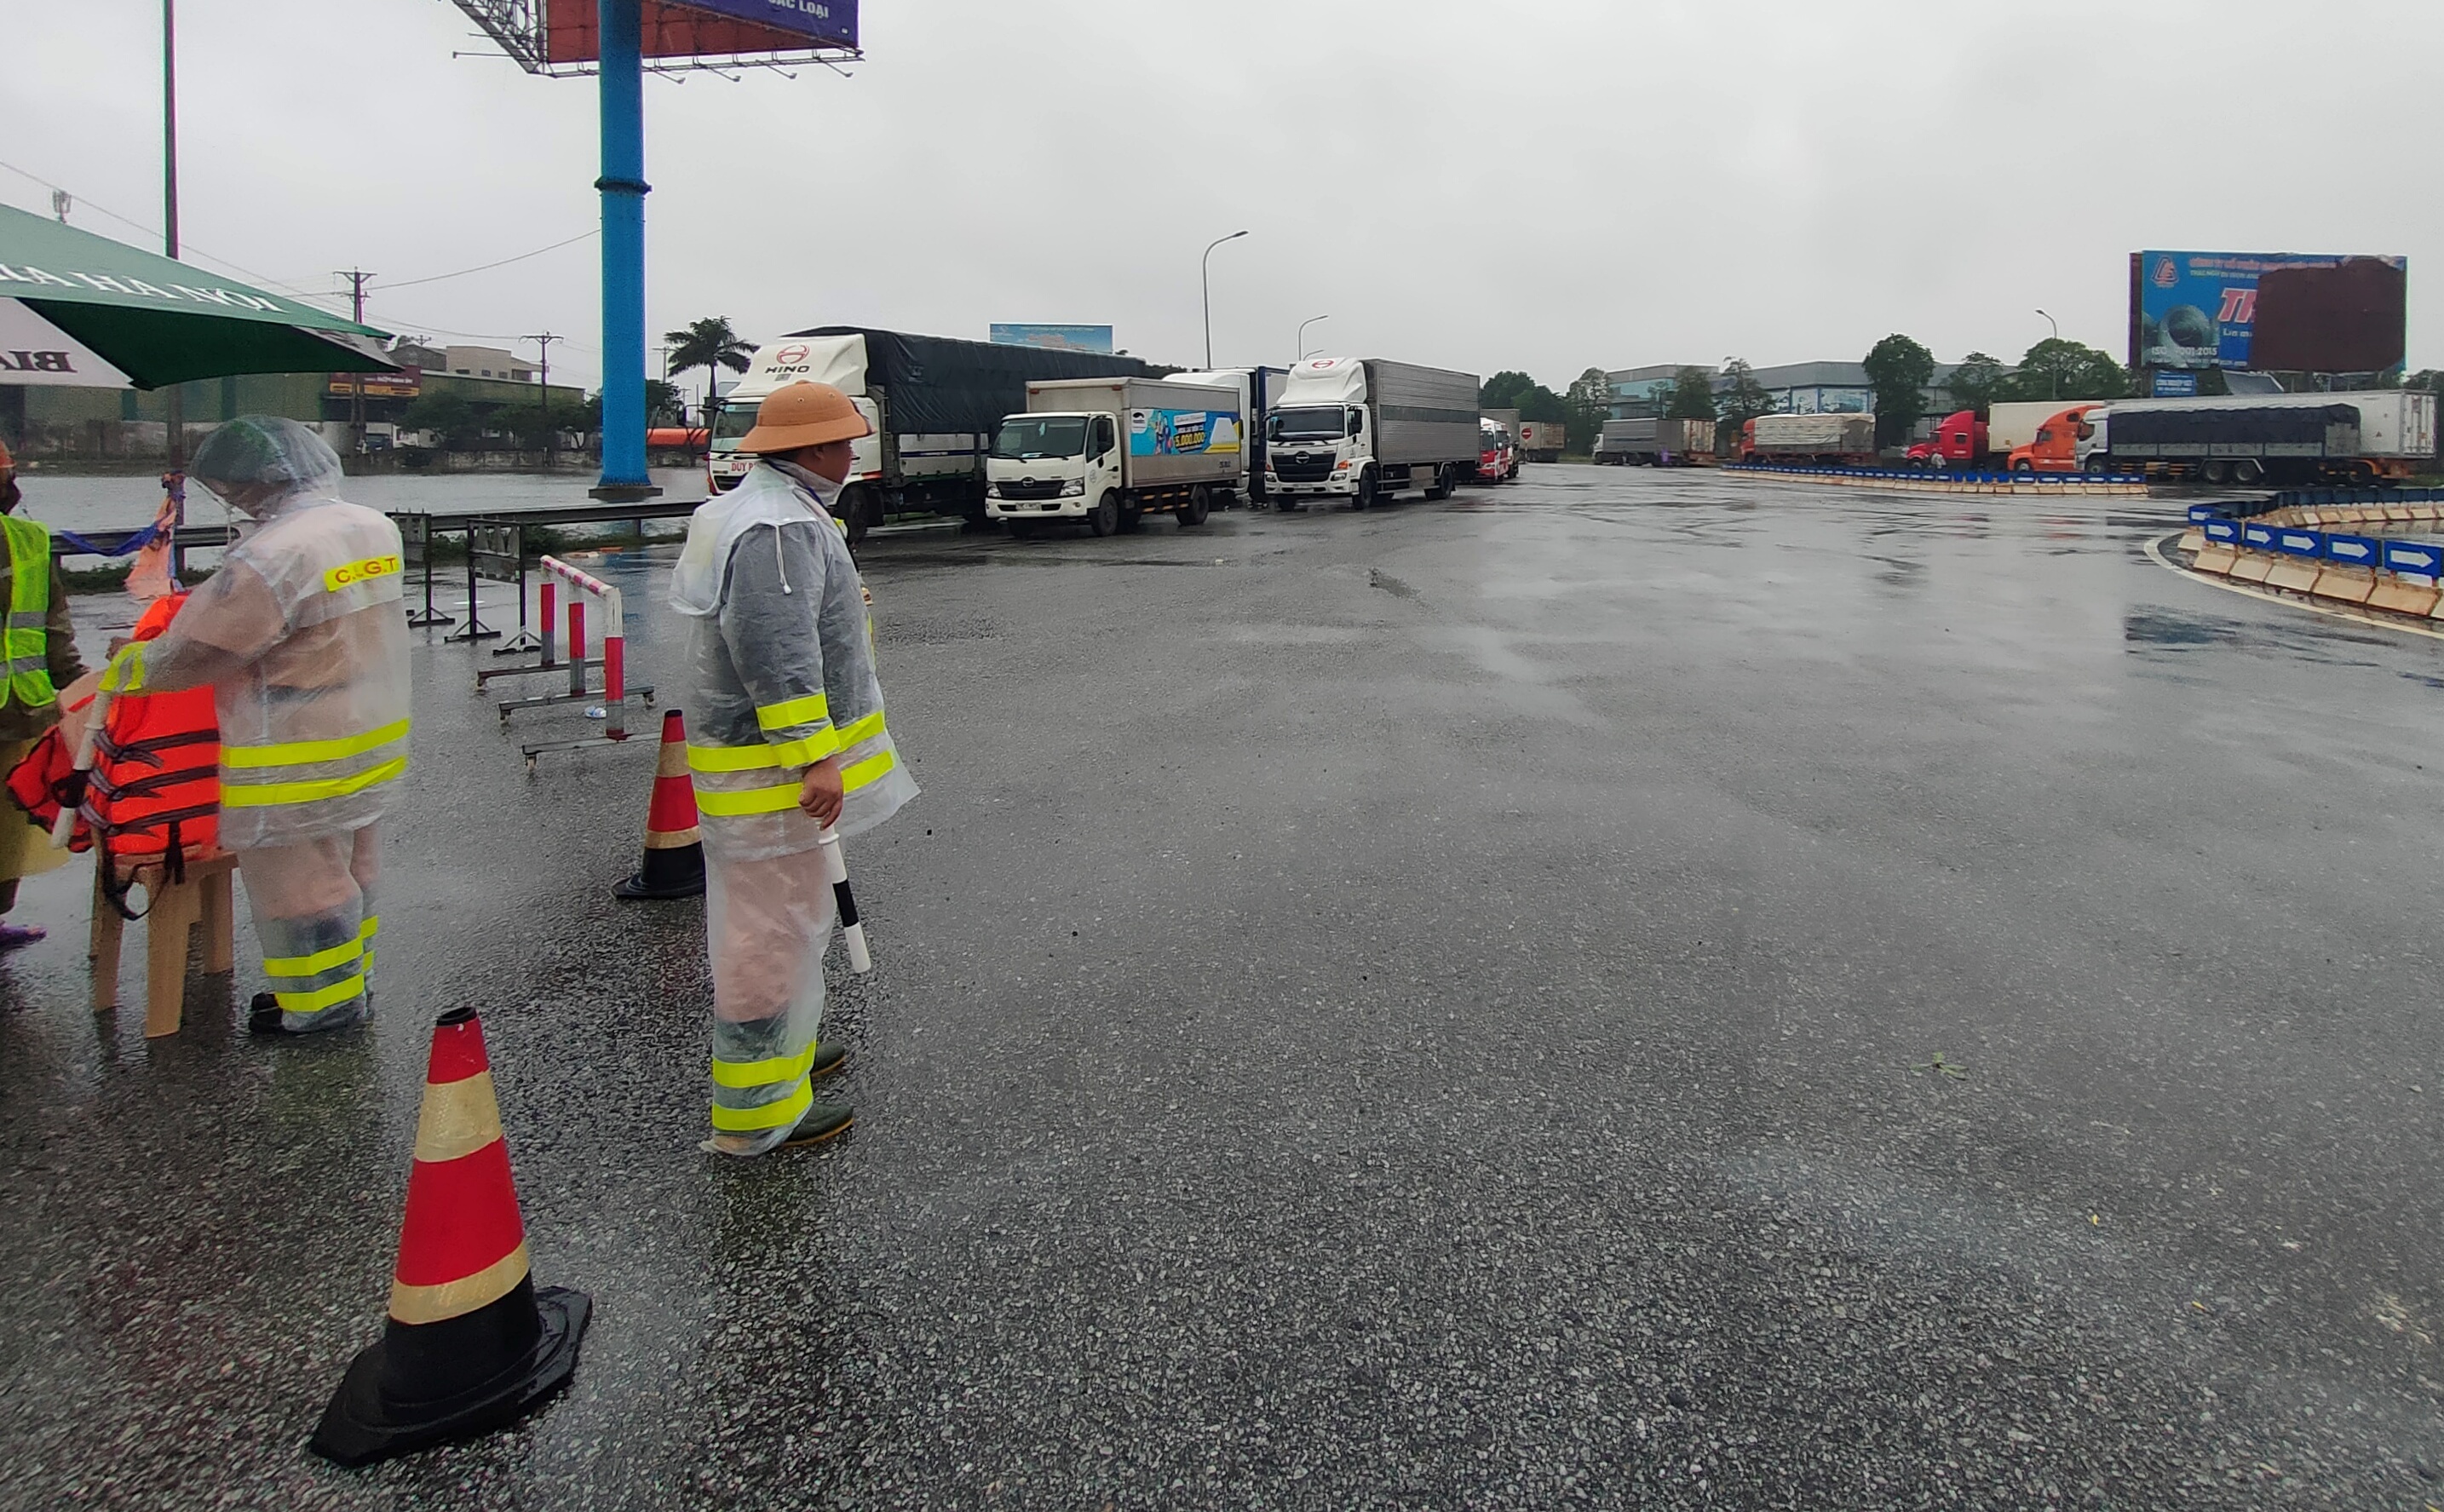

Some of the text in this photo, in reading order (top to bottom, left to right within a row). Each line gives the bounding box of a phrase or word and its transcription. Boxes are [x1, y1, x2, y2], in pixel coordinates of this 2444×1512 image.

[799, 0, 829, 19] LOẠI
[0, 262, 86, 289] IA
[2217, 287, 2257, 323] TI
[2151, 346, 2168, 355] ISO
[764, 365, 811, 374] HINO
[1174, 431, 1205, 447] 5.000.000
[731, 463, 745, 472] DUY
